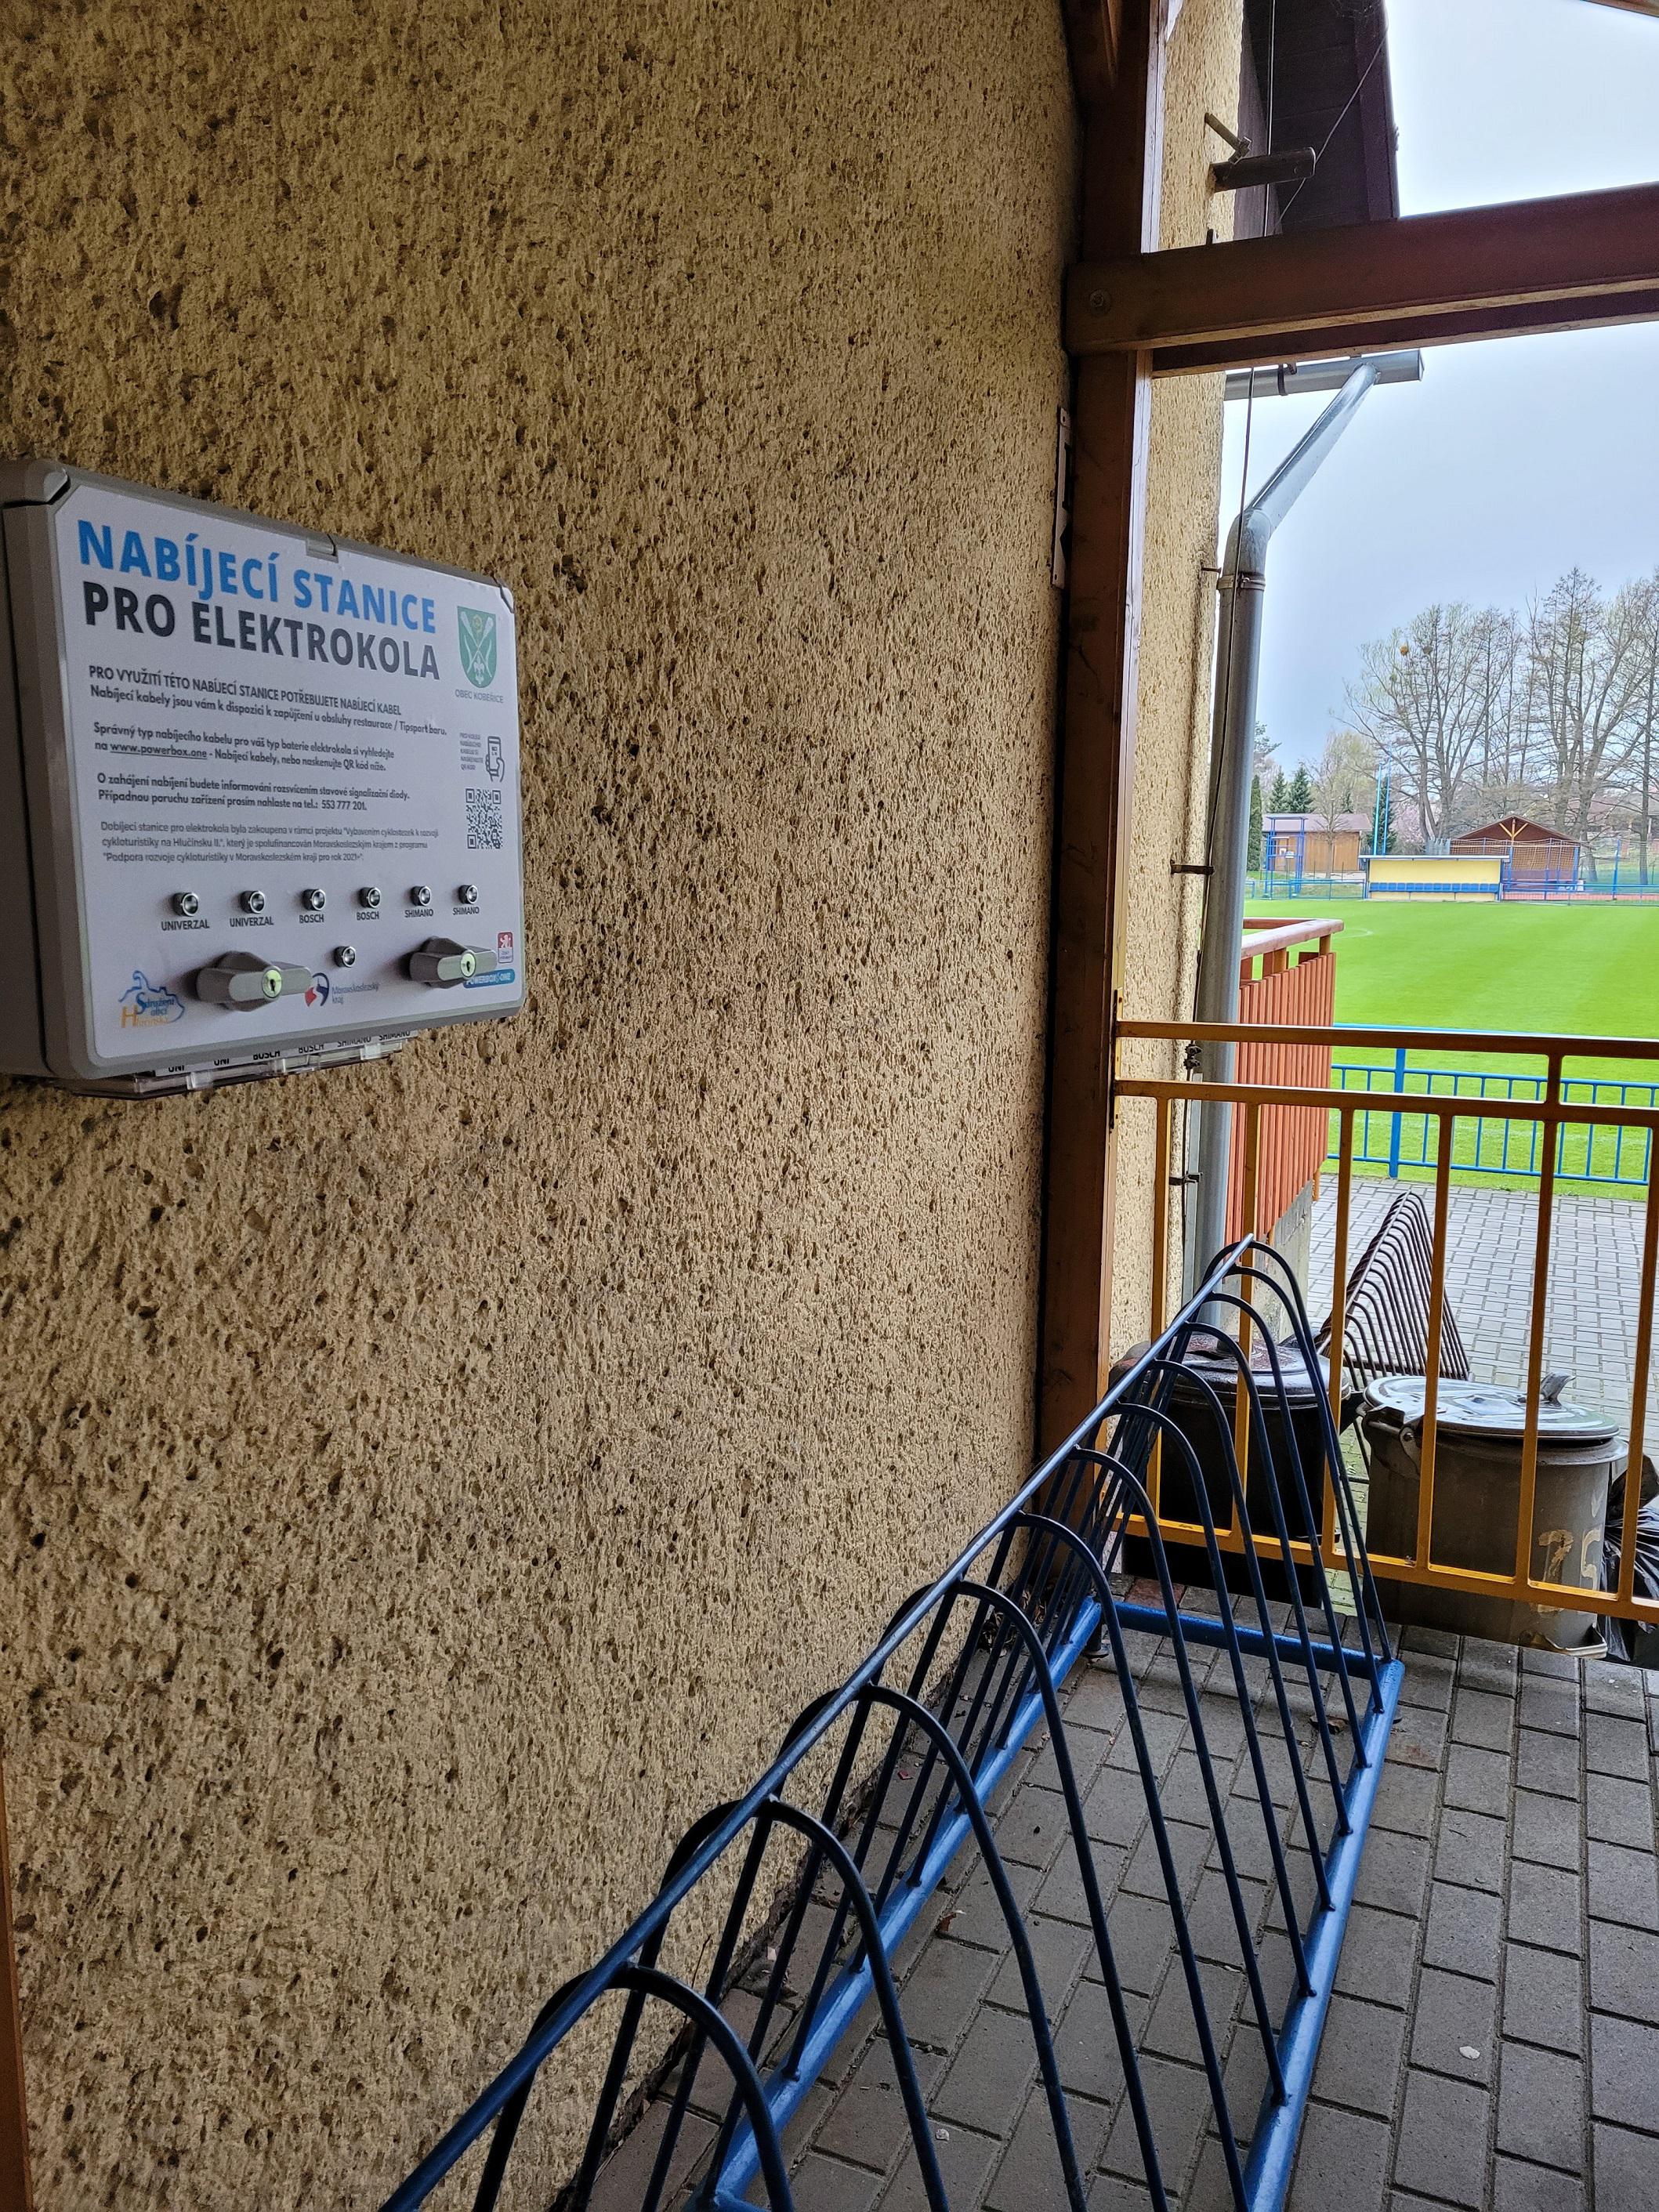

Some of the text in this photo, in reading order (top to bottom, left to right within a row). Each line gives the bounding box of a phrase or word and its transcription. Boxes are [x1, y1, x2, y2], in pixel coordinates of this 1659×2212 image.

[77, 520, 436, 633] NABÍJECÍ STANICE
[82, 581, 440, 679] PRO ELEKTROKOLA
[89, 665, 401, 715] PRO VYUŽITÍ TÉTO NABÍJECÍ STANICE POTŘEBUJETE NABÍJECÍ KABEL
[455, 689, 473, 699] OBEC
[90, 684, 134, 703] Nabíjecí
[136, 690, 170, 708] kabely
[172, 694, 192, 708] jsou
[194, 698, 216, 710] vám
[226, 700, 264, 715] dispozici
[273, 708, 313, 722] zapůjčení
[321, 711, 351, 727] obsluhy
[353, 718, 393, 729] restaurace
[399, 721, 428, 734] Tipsport
[429, 723, 447, 735] baru.
[94, 722, 136, 739] Správný
[138, 727, 153, 740] typ
[155, 729, 201, 743] nabíjecího
[203, 732, 233, 744] kabelu
[234, 738, 249, 748] pro
[250, 737, 265, 748] váš
[266, 739, 280, 751] typ
[281, 738, 309, 751] baterie
[310, 741, 351, 755] elektrokola
[360, 746, 394, 760] vyhledejte
[95, 742, 108, 751] na
[110, 743, 207, 758] www.powerbox.one
[215, 748, 248, 763] Nabíjecí
[281, 754, 300, 765] nebo
[302, 756, 342, 770] naskenujte
[343, 758, 355, 770] QR
[356, 760, 368, 770] kód
[97, 773, 106, 784] O
[108, 773, 150, 788] zahájení
[151, 775, 188, 790] nabíjení
[190, 777, 219, 790] budete
[273, 784, 318, 795] rozsvícením
[320, 787, 347, 796] stavové
[389, 789, 410, 802] diody.
[98, 789, 149, 804] Případnou
[151, 792, 189, 805] poruchu
[190, 794, 225, 805] zařízení
[226, 796, 255, 808] prosím
[257, 796, 291, 808] nahlaste
[321, 800, 335, 809] 553
[336, 801, 351, 810] 777
[138, 821, 168, 832] stanice
[170, 824, 184, 834] pro
[230, 824, 246, 834] byla
[246, 839, 253, 849] je
[145, 853, 175, 863] rozvoje
[319, 853, 330, 863] pro
[331, 853, 341, 861] rok
[357, 911, 379, 921] BOSCH
[404, 908, 434, 918] SHIMANO
[452, 906, 480, 916] SHIMANO
[161, 919, 210, 931] UNIVERZAL
[230, 916, 273, 927] UNIVERZAL
[299, 914, 324, 924] BOSCH
